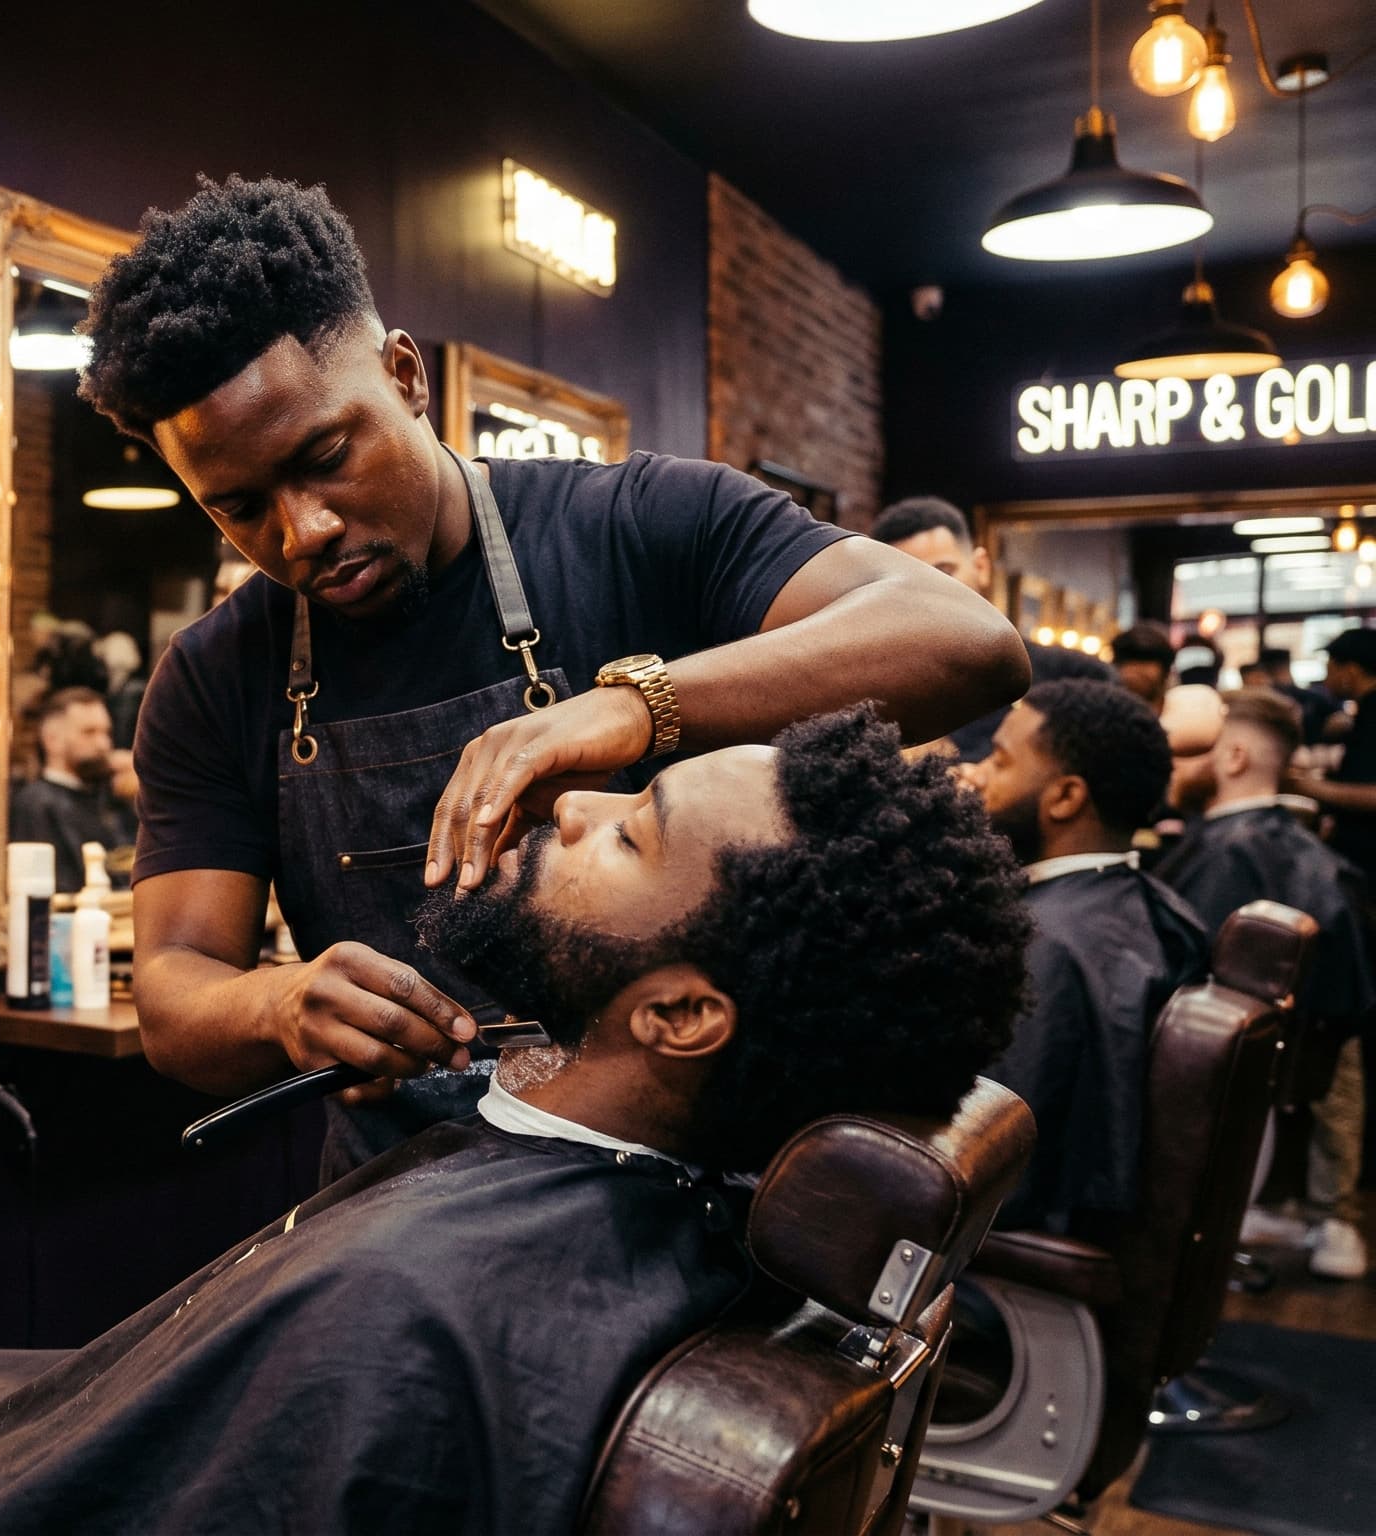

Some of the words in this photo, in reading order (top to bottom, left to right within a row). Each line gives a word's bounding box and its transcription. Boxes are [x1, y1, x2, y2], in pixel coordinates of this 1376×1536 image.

[1017, 376, 1193, 454] SHARP
[1200, 373, 1245, 442] &
[1254, 361, 1376, 439] GOL
